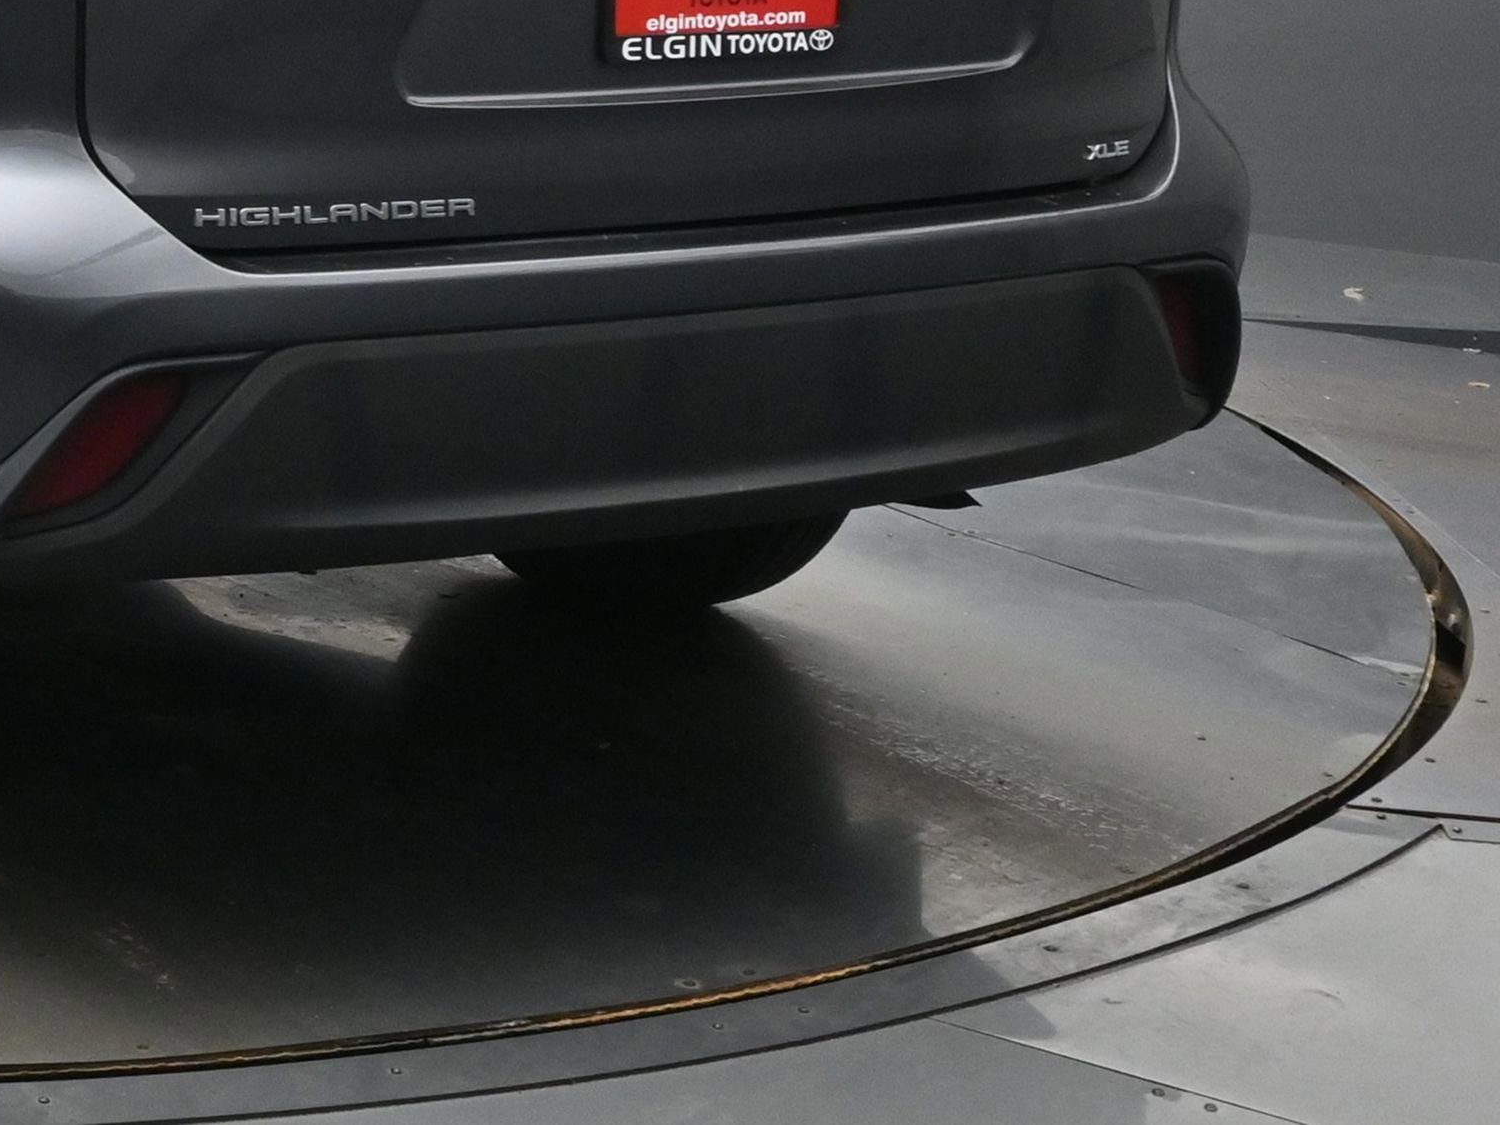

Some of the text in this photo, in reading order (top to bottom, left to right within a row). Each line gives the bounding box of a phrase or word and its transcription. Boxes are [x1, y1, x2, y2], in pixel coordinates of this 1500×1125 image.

[646, 11, 806, 34] elgintoyota.com
[621, 32, 809, 61] ELGIN TOYOTA
[1084, 140, 1130, 161] XLE
[194, 197, 476, 227] HIGHLANDER
